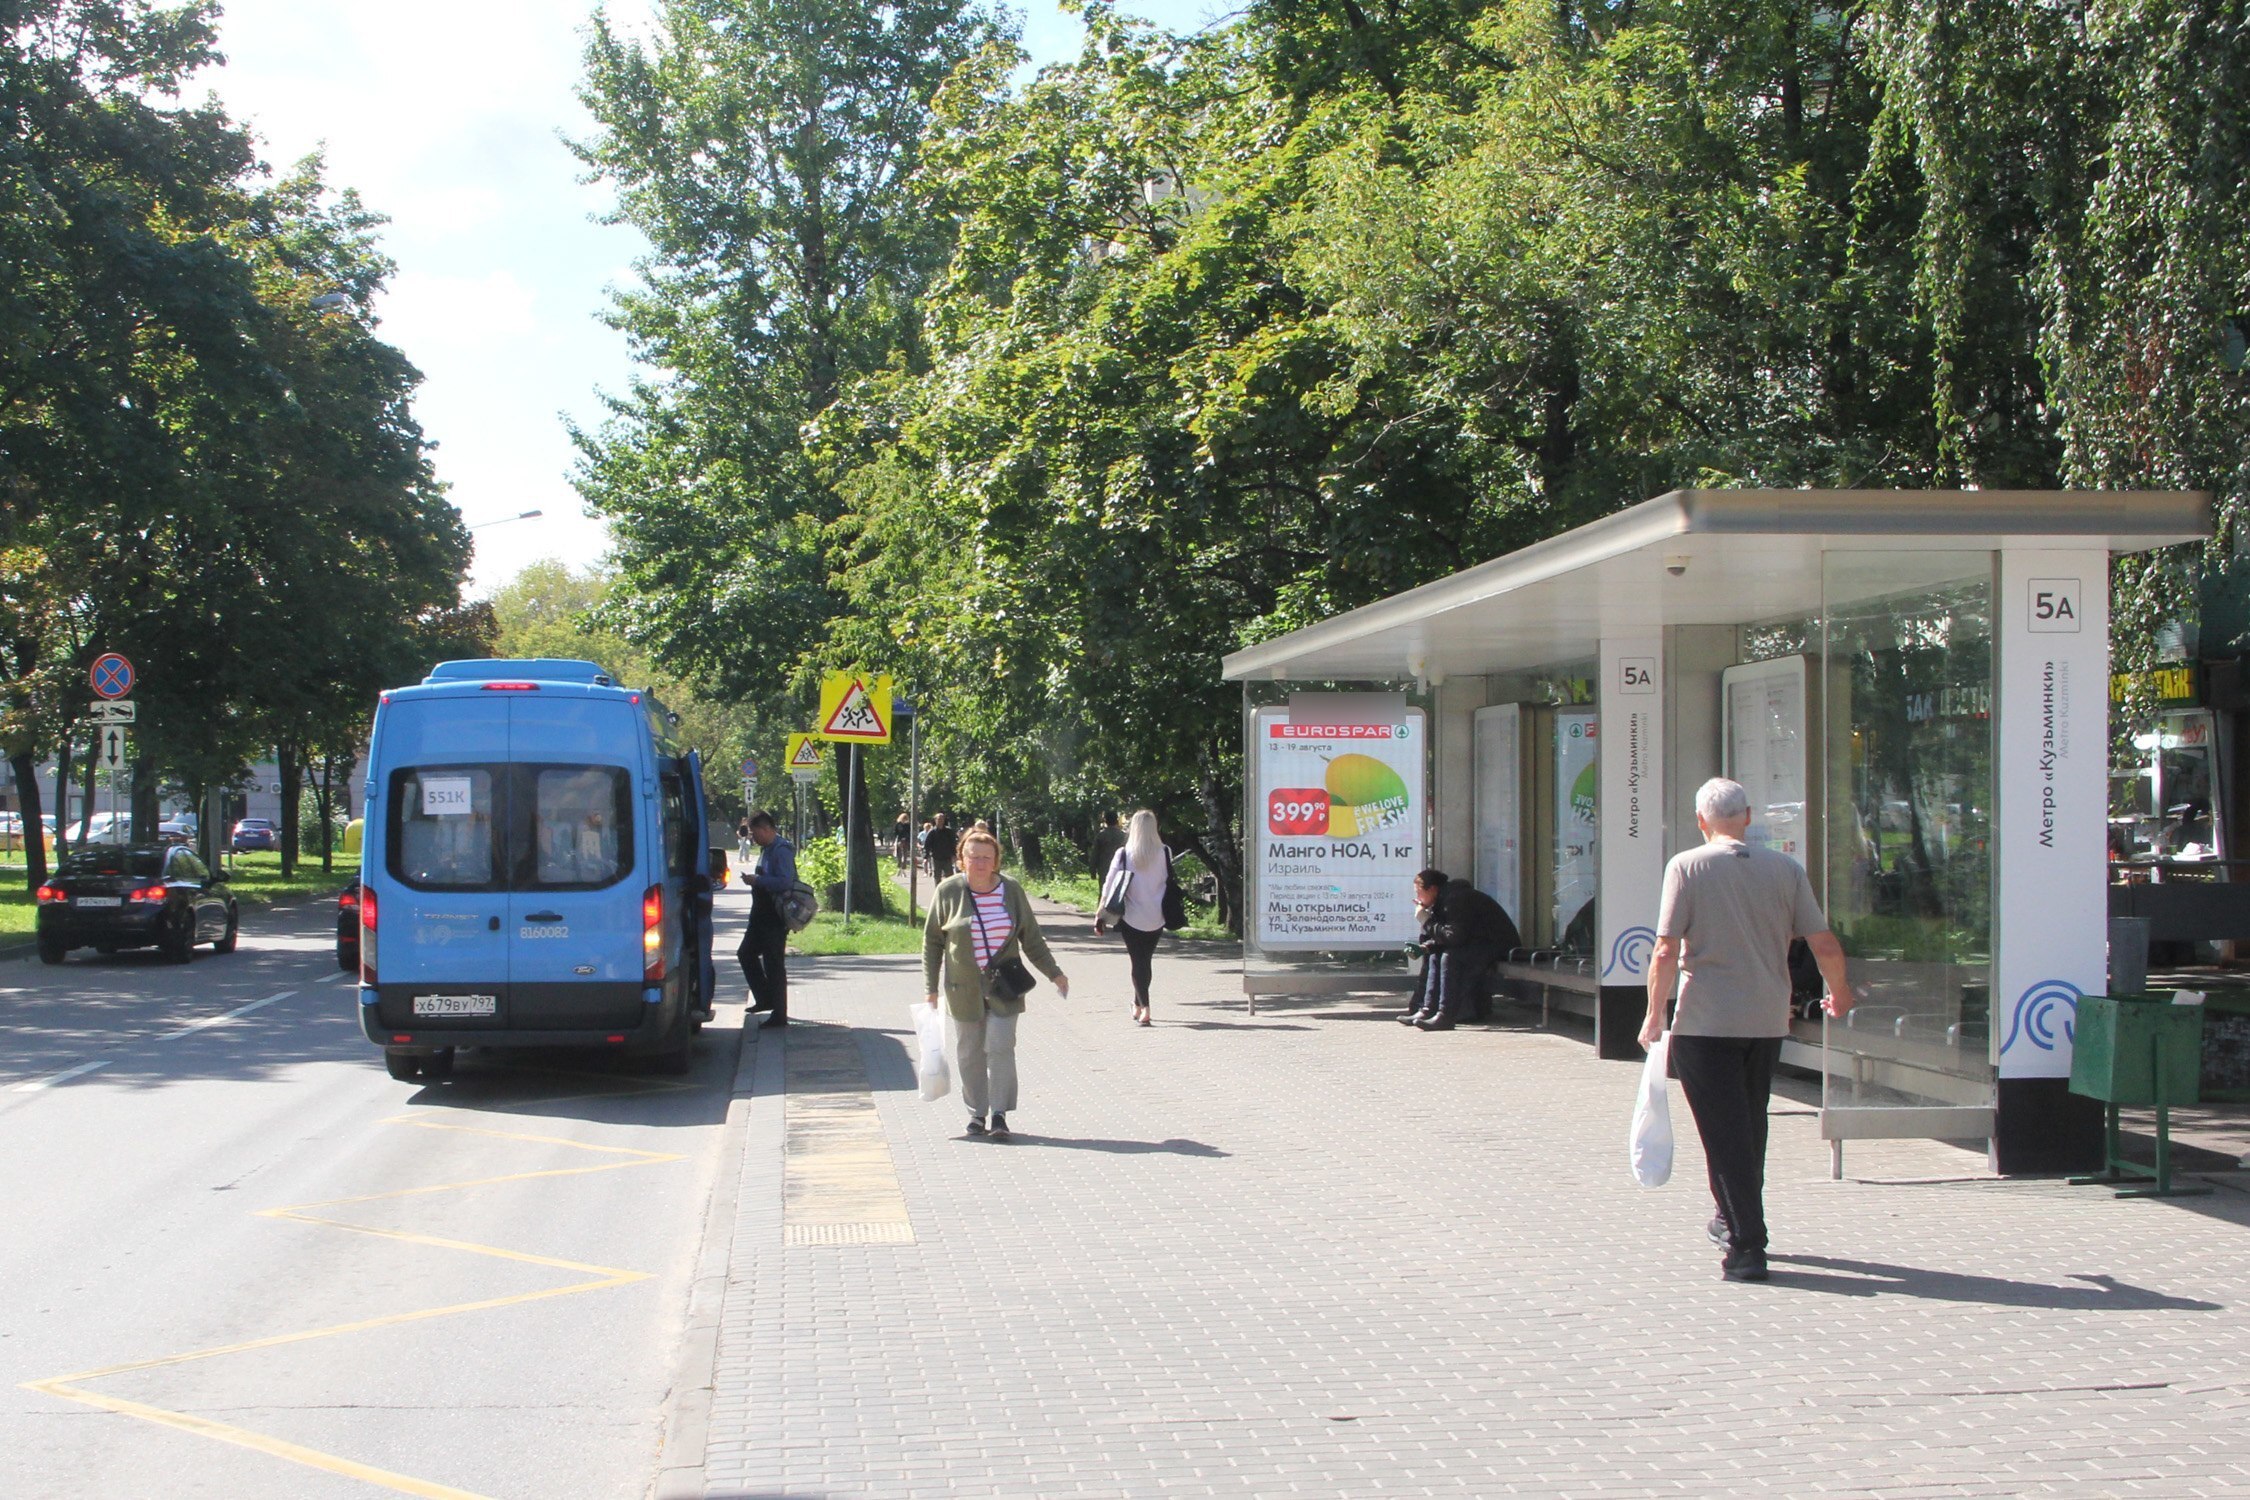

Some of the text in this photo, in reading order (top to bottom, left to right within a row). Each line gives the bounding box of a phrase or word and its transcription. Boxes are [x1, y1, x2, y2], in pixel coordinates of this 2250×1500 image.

[2035, 592, 2075, 620] 5А
[1624, 667, 1651, 685] 5А
[2059, 660, 2069, 760] Metro Kuzminki
[1283, 726, 1391, 736] EUROSPAR
[1269, 743, 1278, 751] 13
[1287, 743, 1296, 751] 19
[1299, 744, 1332, 752] августа
[2039, 660, 2057, 848] Метро «Кузьминки»
[1640, 752, 1648, 779] Metro
[1628, 712, 1640, 839] Метро «Кузьминки»
[428, 791, 465, 804] 551К
[1379, 796, 1404, 810] LOVE
[1273, 803, 1314, 822] 399
[1356, 807, 1409, 835] FRESH
[1269, 843, 1412, 860] Манго НОА, 1 кг
[1268, 863, 1321, 875] Израиль
[1269, 902, 1370, 915] Мы открылись!
[1287, 914, 1370, 923] Зеленодольская,
[1374, 914, 1386, 922] 42
[520, 927, 568, 939] 8160082
[1269, 923, 1376, 934] ТРЦ Кузьминки Молл
[471, 997, 491, 1007] 797
